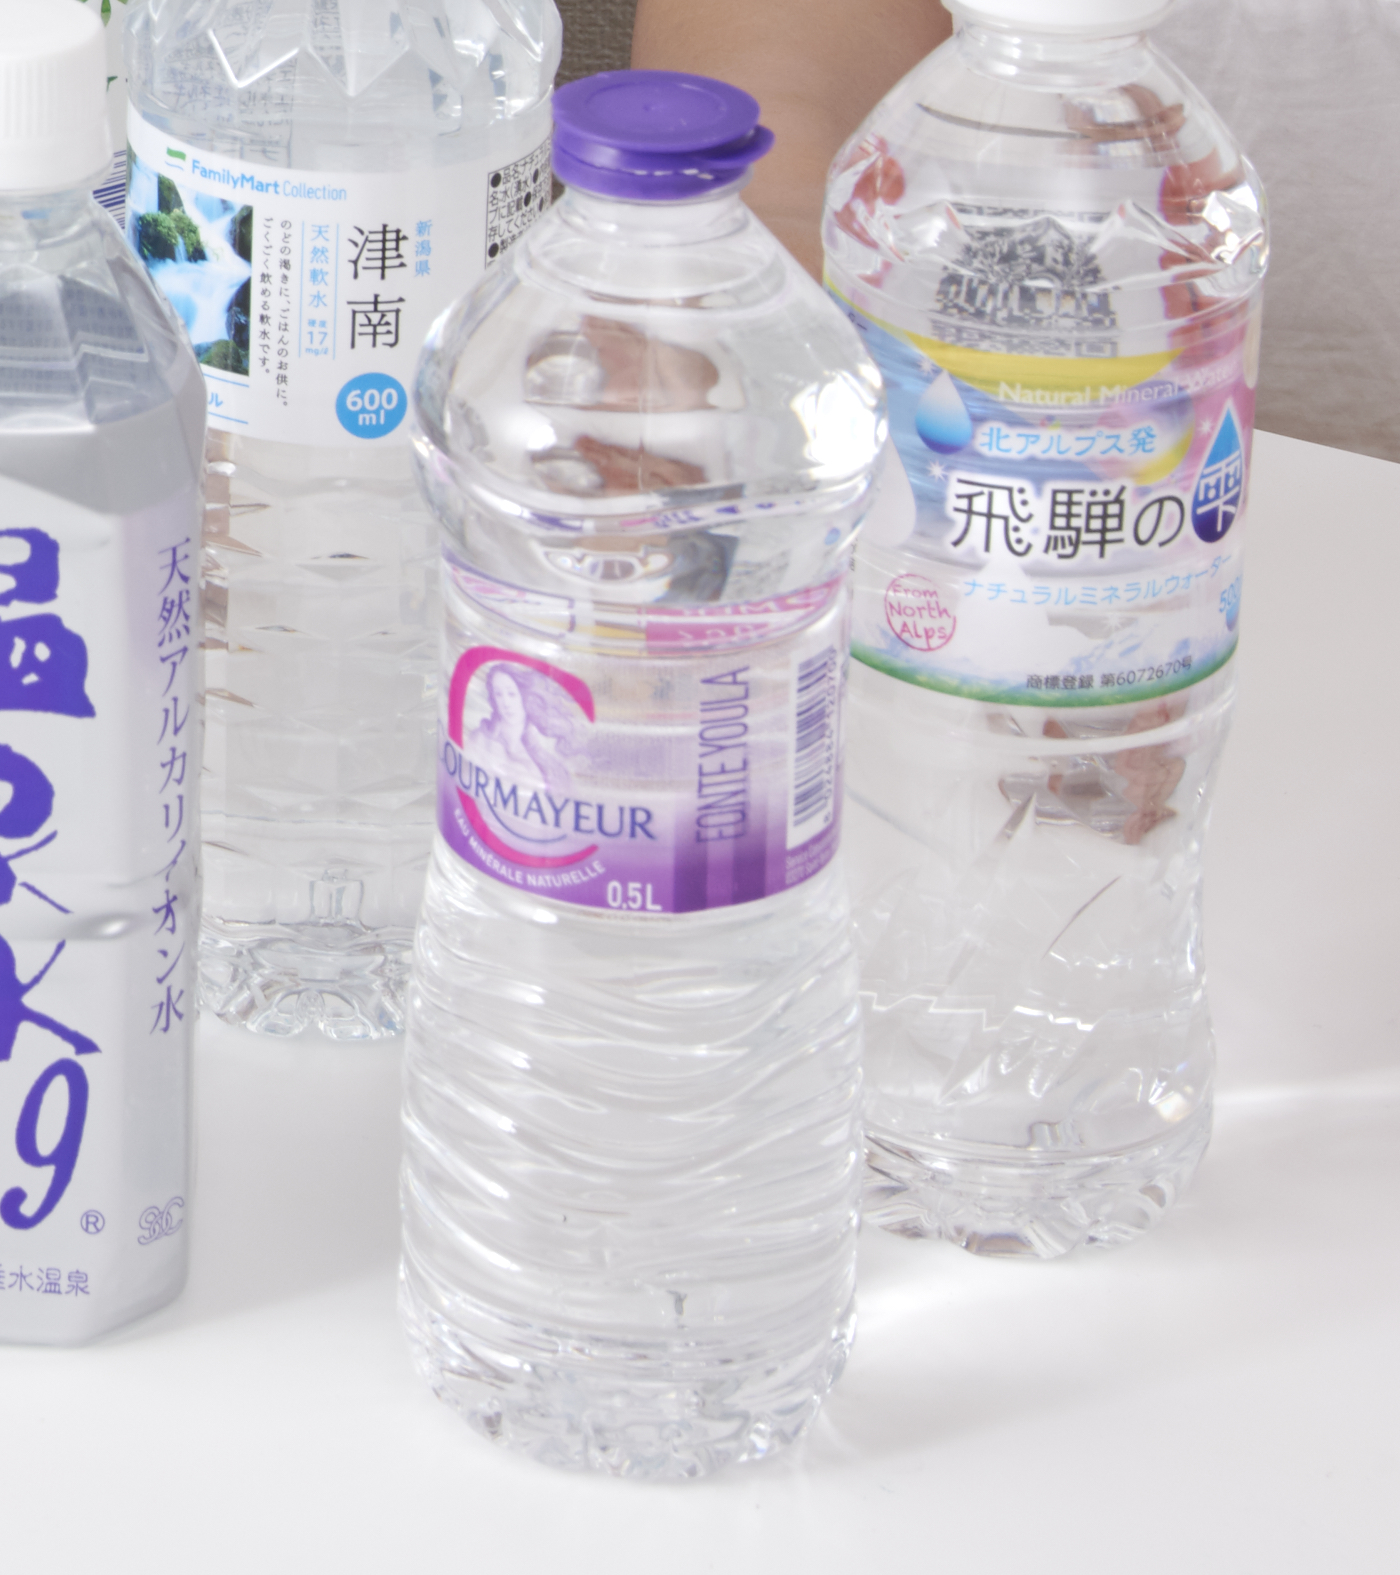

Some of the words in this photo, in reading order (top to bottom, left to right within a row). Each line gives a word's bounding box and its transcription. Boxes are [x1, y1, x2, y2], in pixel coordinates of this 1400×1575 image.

[191, 159, 281, 195] FamilyMart
[282, 180, 347, 202] Collection
[309, 224, 330, 309] 天然軟水
[414, 219, 434, 278] 新潟県
[258, 217, 274, 375] ごくごく飲める軟水です。
[346, 223, 409, 350] 津南
[276, 219, 292, 408] のどの渇きに、ごはんのお供に。
[307, 330, 328, 345] 17
[346, 388, 398, 411] 600
[999, 381, 1091, 406] Natural
[1101, 378, 1181, 404] Mineral
[357, 411, 386, 426] ml
[978, 425, 1158, 457] 北アルプス発
[892, 583, 939, 601] From
[963, 553, 1232, 607] ナチュラルミネラルウォーター
[888, 600, 952, 620] North
[898, 620, 949, 646] Alps
[1026, 673, 1096, 691] 商標登録
[1100, 655, 1194, 688] 第6072670号
[698, 664, 752, 760] YOULA
[148, 535, 193, 1036] 天然アルカリイオン水
[696, 759, 749, 845] FONTE
[453, 807, 470, 838] EAU
[525, 859, 607, 889] NATURELLE
